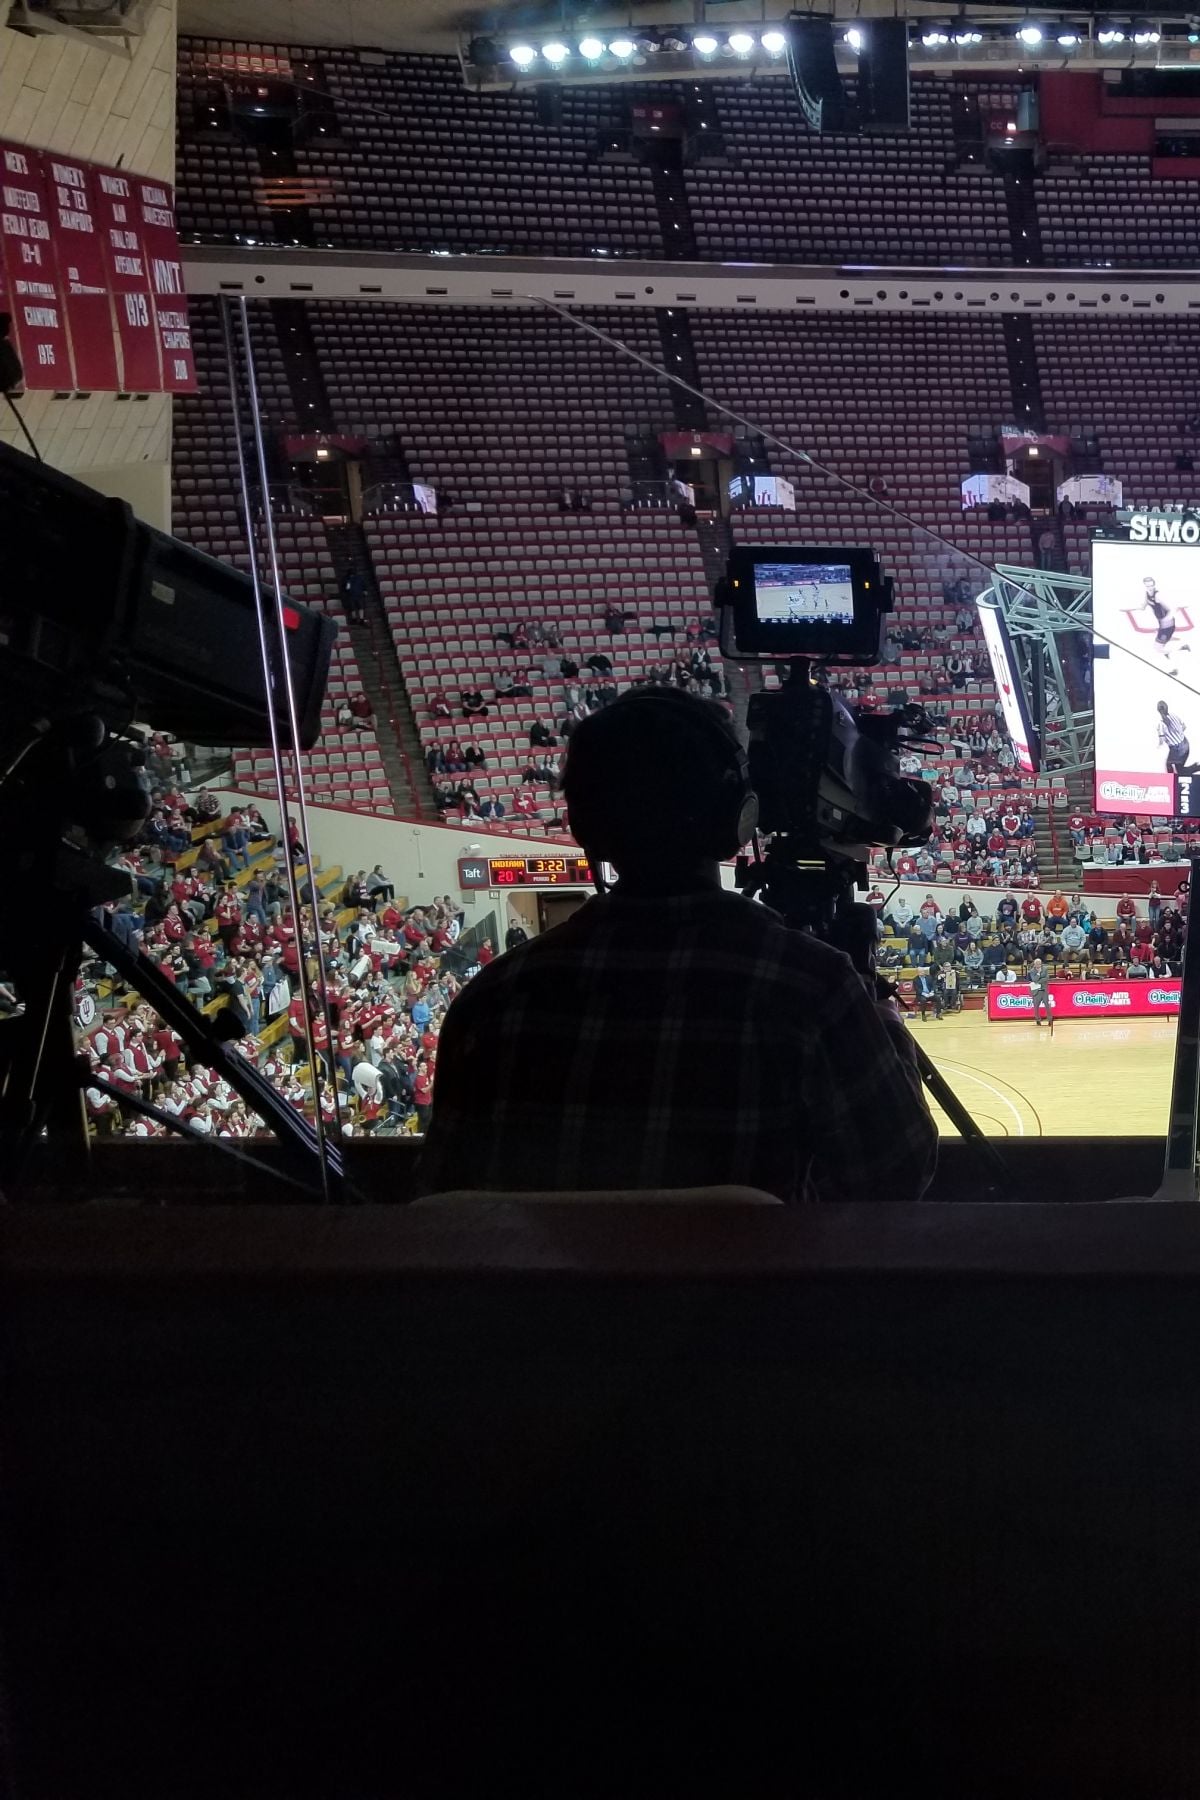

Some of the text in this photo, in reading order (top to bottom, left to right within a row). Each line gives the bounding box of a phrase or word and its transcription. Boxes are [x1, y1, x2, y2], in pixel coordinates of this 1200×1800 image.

[125, 293, 149, 326] 1973
[491, 860, 525, 868] INDIANA
[537, 860, 563, 872] 3:22
[463, 868, 481, 879] Taft
[498, 870, 514, 882] 20
[550, 874, 557, 882] 2
[999, 995, 1033, 1009] O'Reilly
[1075, 992, 1108, 1006] O'Reilly
